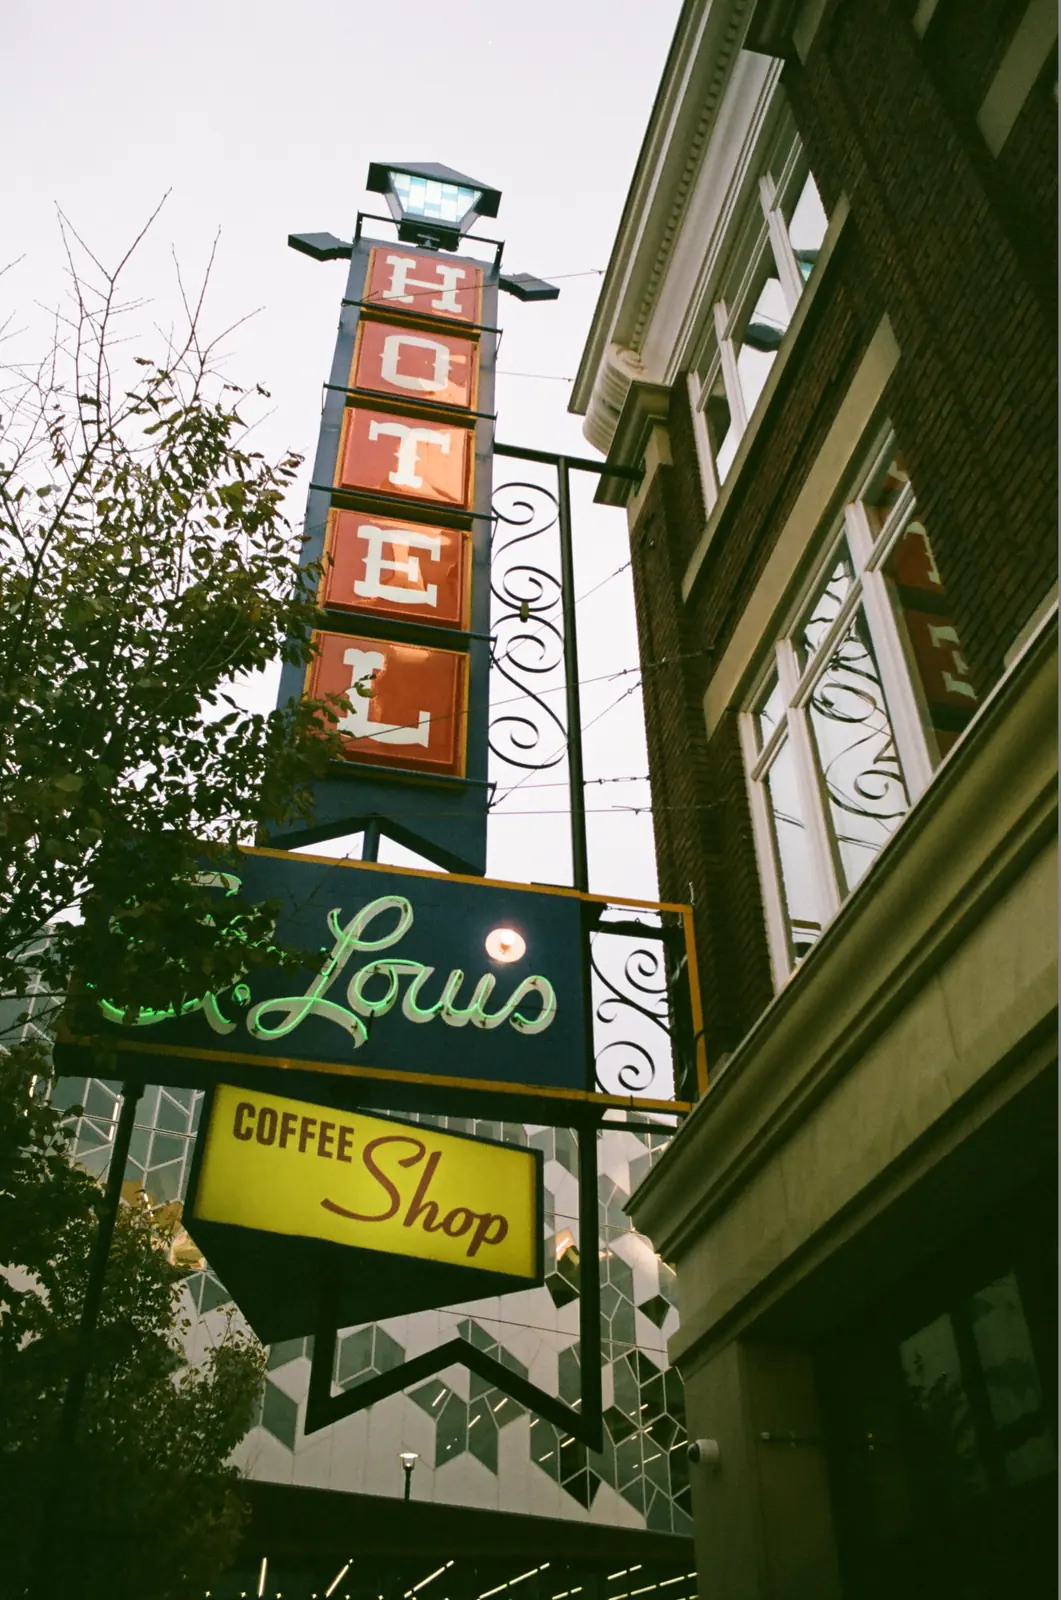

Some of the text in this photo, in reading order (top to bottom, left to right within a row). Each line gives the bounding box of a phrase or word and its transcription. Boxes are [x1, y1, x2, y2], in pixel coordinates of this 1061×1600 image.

[336, 255, 466, 749] HOTEL
[247, 895, 557, 1049] Louis
[232, 1102, 508, 1257] COFFEE Shop
